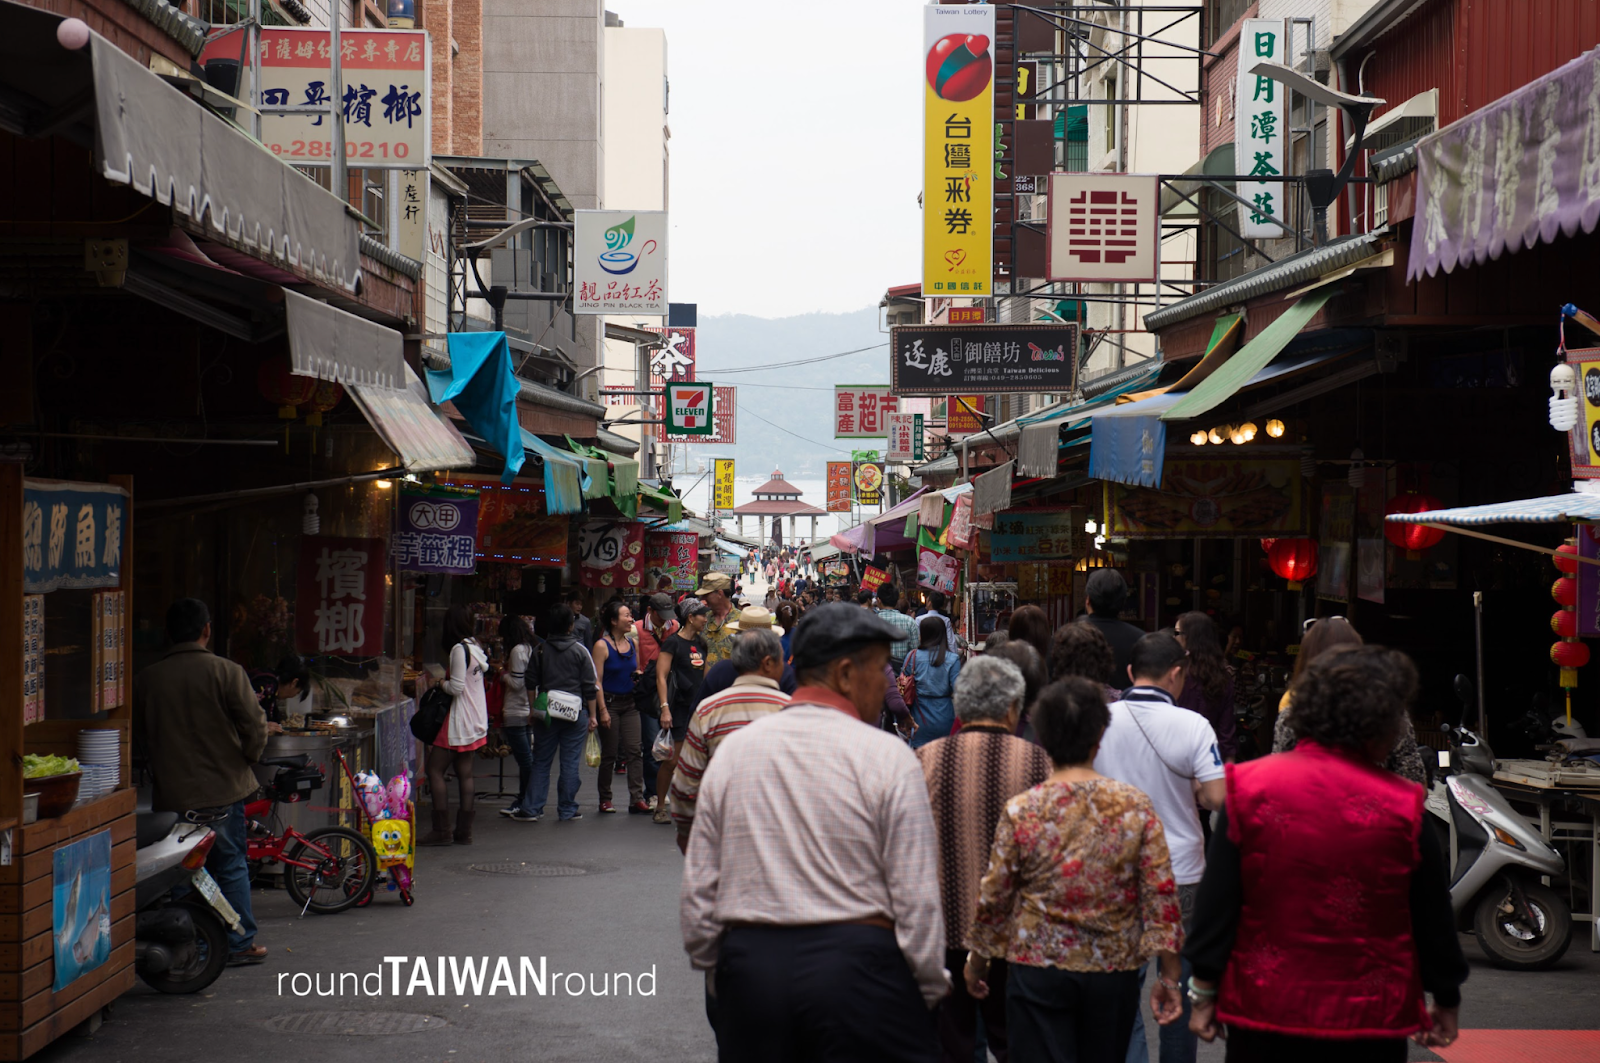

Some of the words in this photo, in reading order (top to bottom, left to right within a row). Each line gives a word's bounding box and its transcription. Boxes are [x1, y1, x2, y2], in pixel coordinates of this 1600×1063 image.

[963, 8, 988, 16] Lottery
[1249, 32, 1279, 225] 日月潭茶莊
[944, 113, 973, 235] 台灣彩券
[579, 279, 663, 301] 靚品紅茶
[934, 282, 983, 291] 中國信託
[951, 311, 982, 321] 日月潭
[903, 339, 953, 377] 逐鹿
[858, 392, 898, 433] 超市
[415, 506, 454, 527] 大甲
[676, 546, 693, 578] 紅茶
[313, 547, 369, 654] 檳榔
